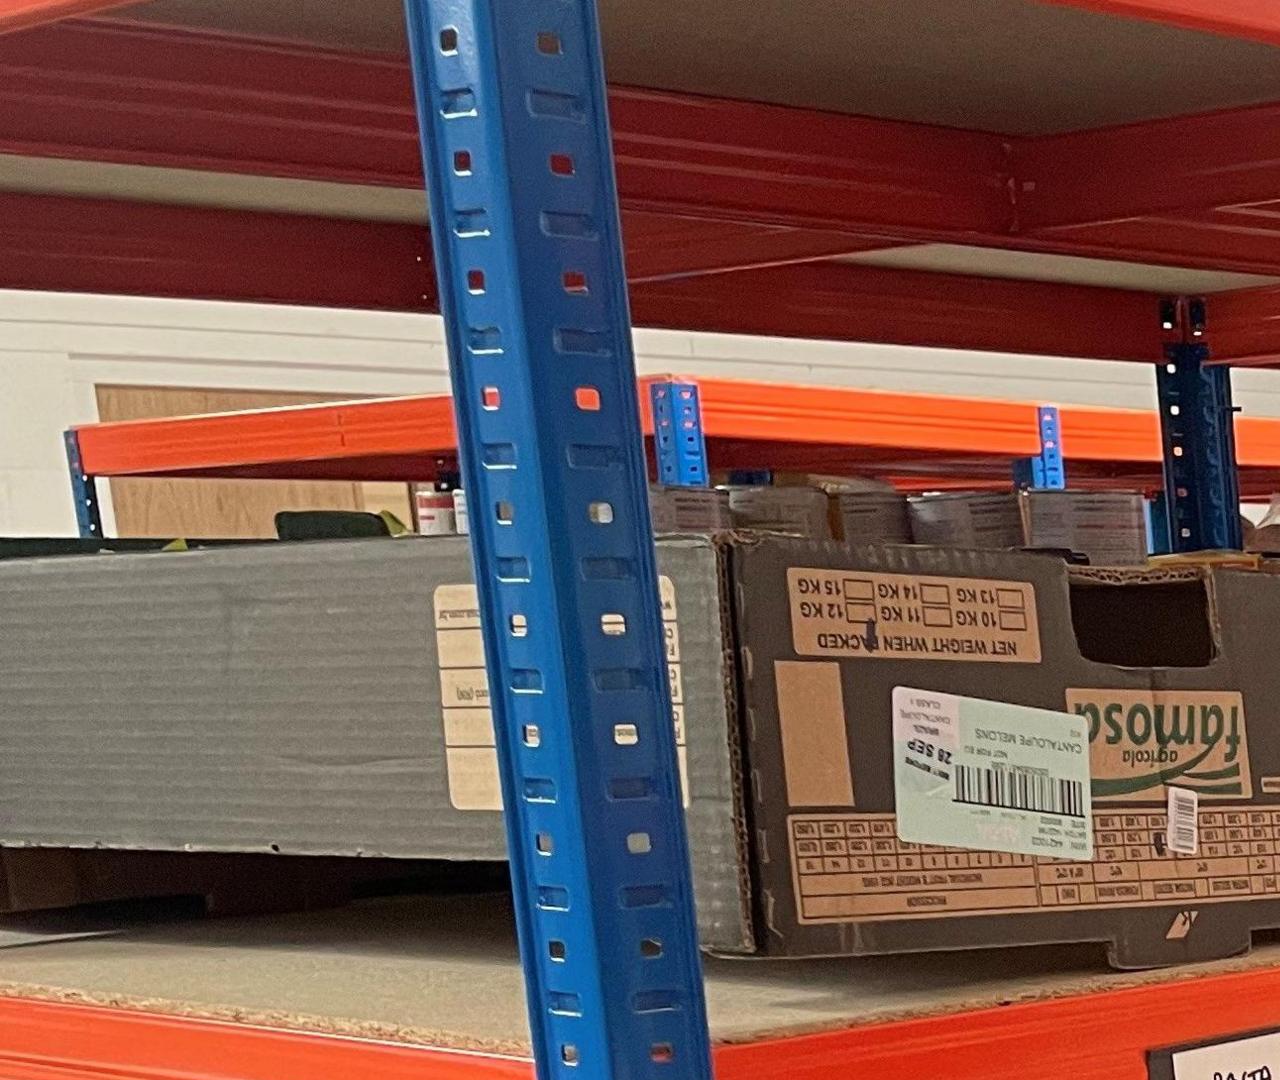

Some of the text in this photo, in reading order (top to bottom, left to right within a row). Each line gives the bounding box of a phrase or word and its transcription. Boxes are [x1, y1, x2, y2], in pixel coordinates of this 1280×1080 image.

[798, 579, 841, 595] 15 KG
[878, 584, 917, 600] 14 KG
[957, 589, 995, 603] 13 KG
[800, 602, 843, 618] 12 KG
[881, 607, 920, 622] 11 KG
[956, 610, 996, 626] 10 KG
[884, 635, 928, 652] WHEN
[931, 637, 987, 655] WEIGHT
[991, 640, 1017, 655] NET
[1074, 703, 1240, 762] famosa
[907, 739, 934, 758] SEP
[975, 728, 1083, 754] CANTALOUPE MELONS
